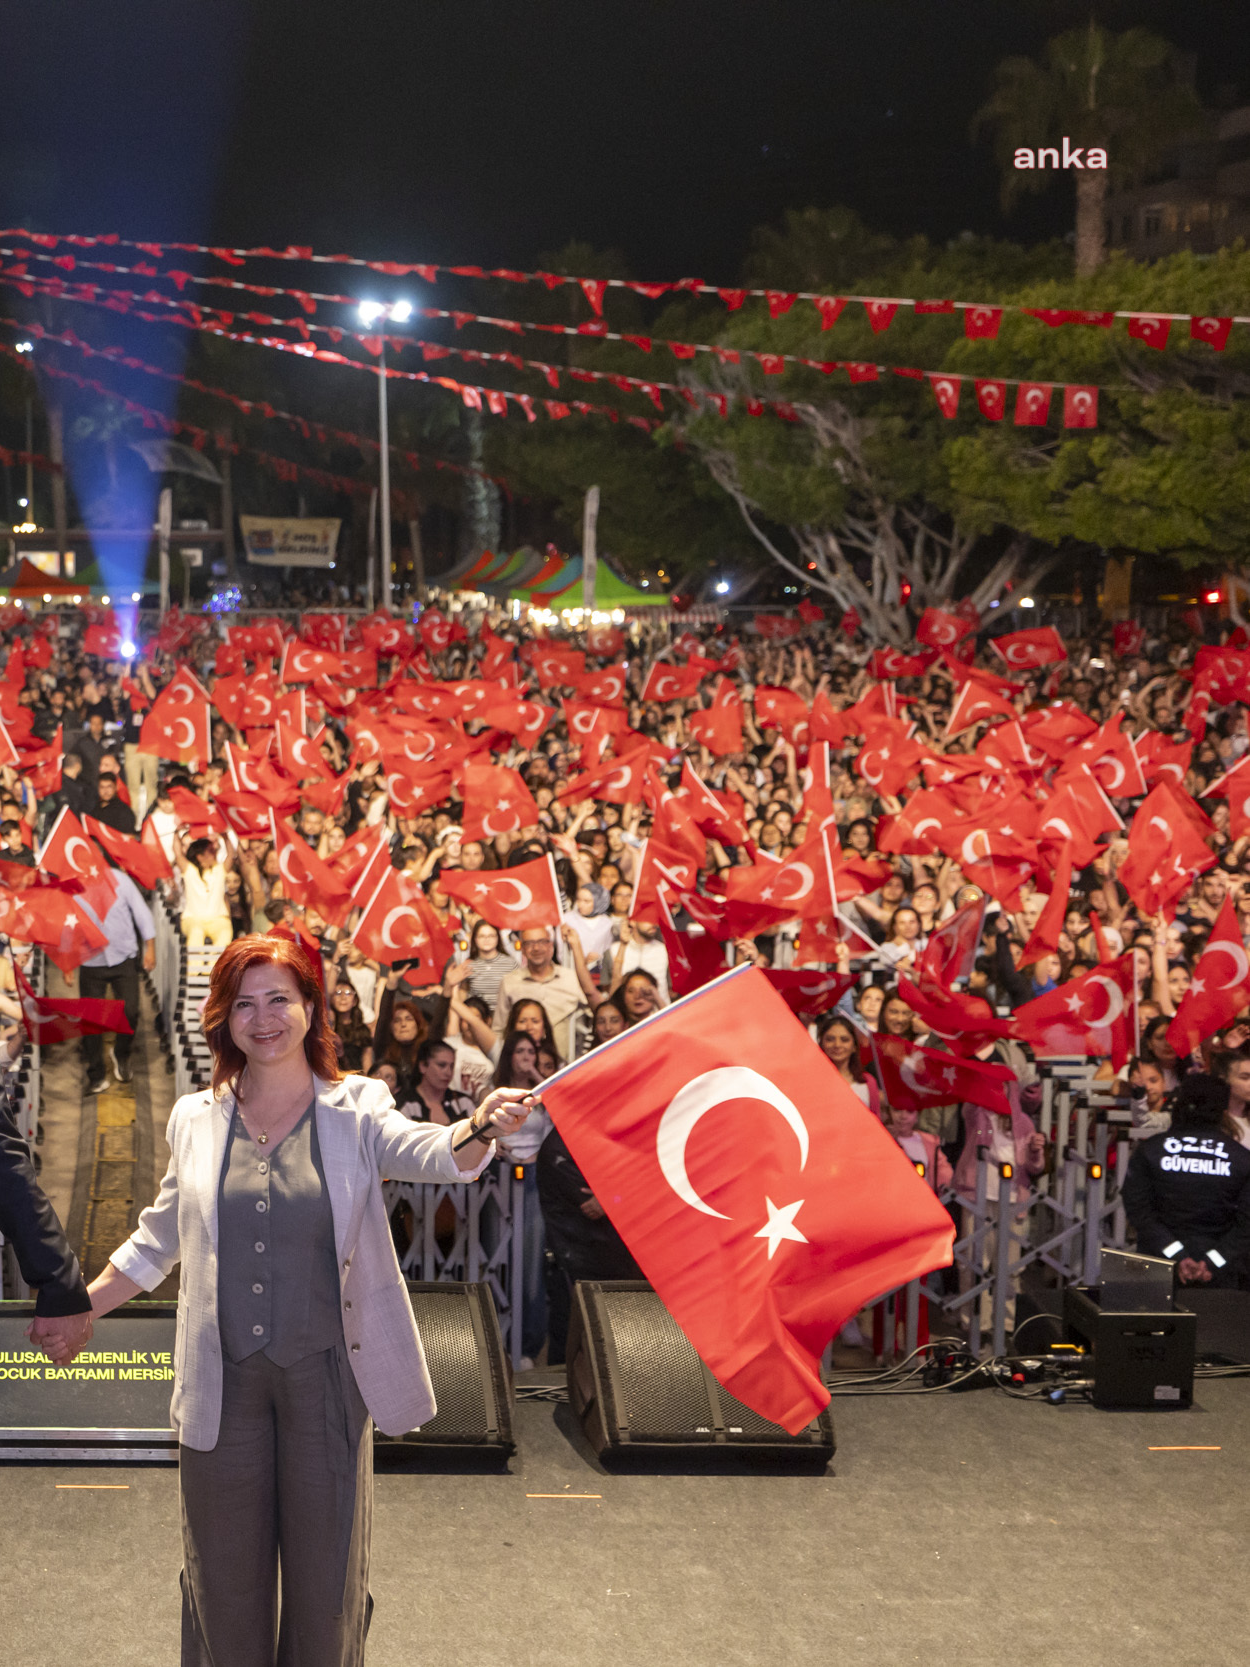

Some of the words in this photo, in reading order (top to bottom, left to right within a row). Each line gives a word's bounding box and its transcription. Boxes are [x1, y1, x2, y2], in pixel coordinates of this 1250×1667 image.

[1163, 1136, 1229, 1159] ÖZEL
[1160, 1154, 1231, 1177] GÜVENLİK
[71, 1350, 149, 1364] EMENLİK
[150, 1352, 172, 1364] VE
[45, 1368, 115, 1380] BAYRAMI
